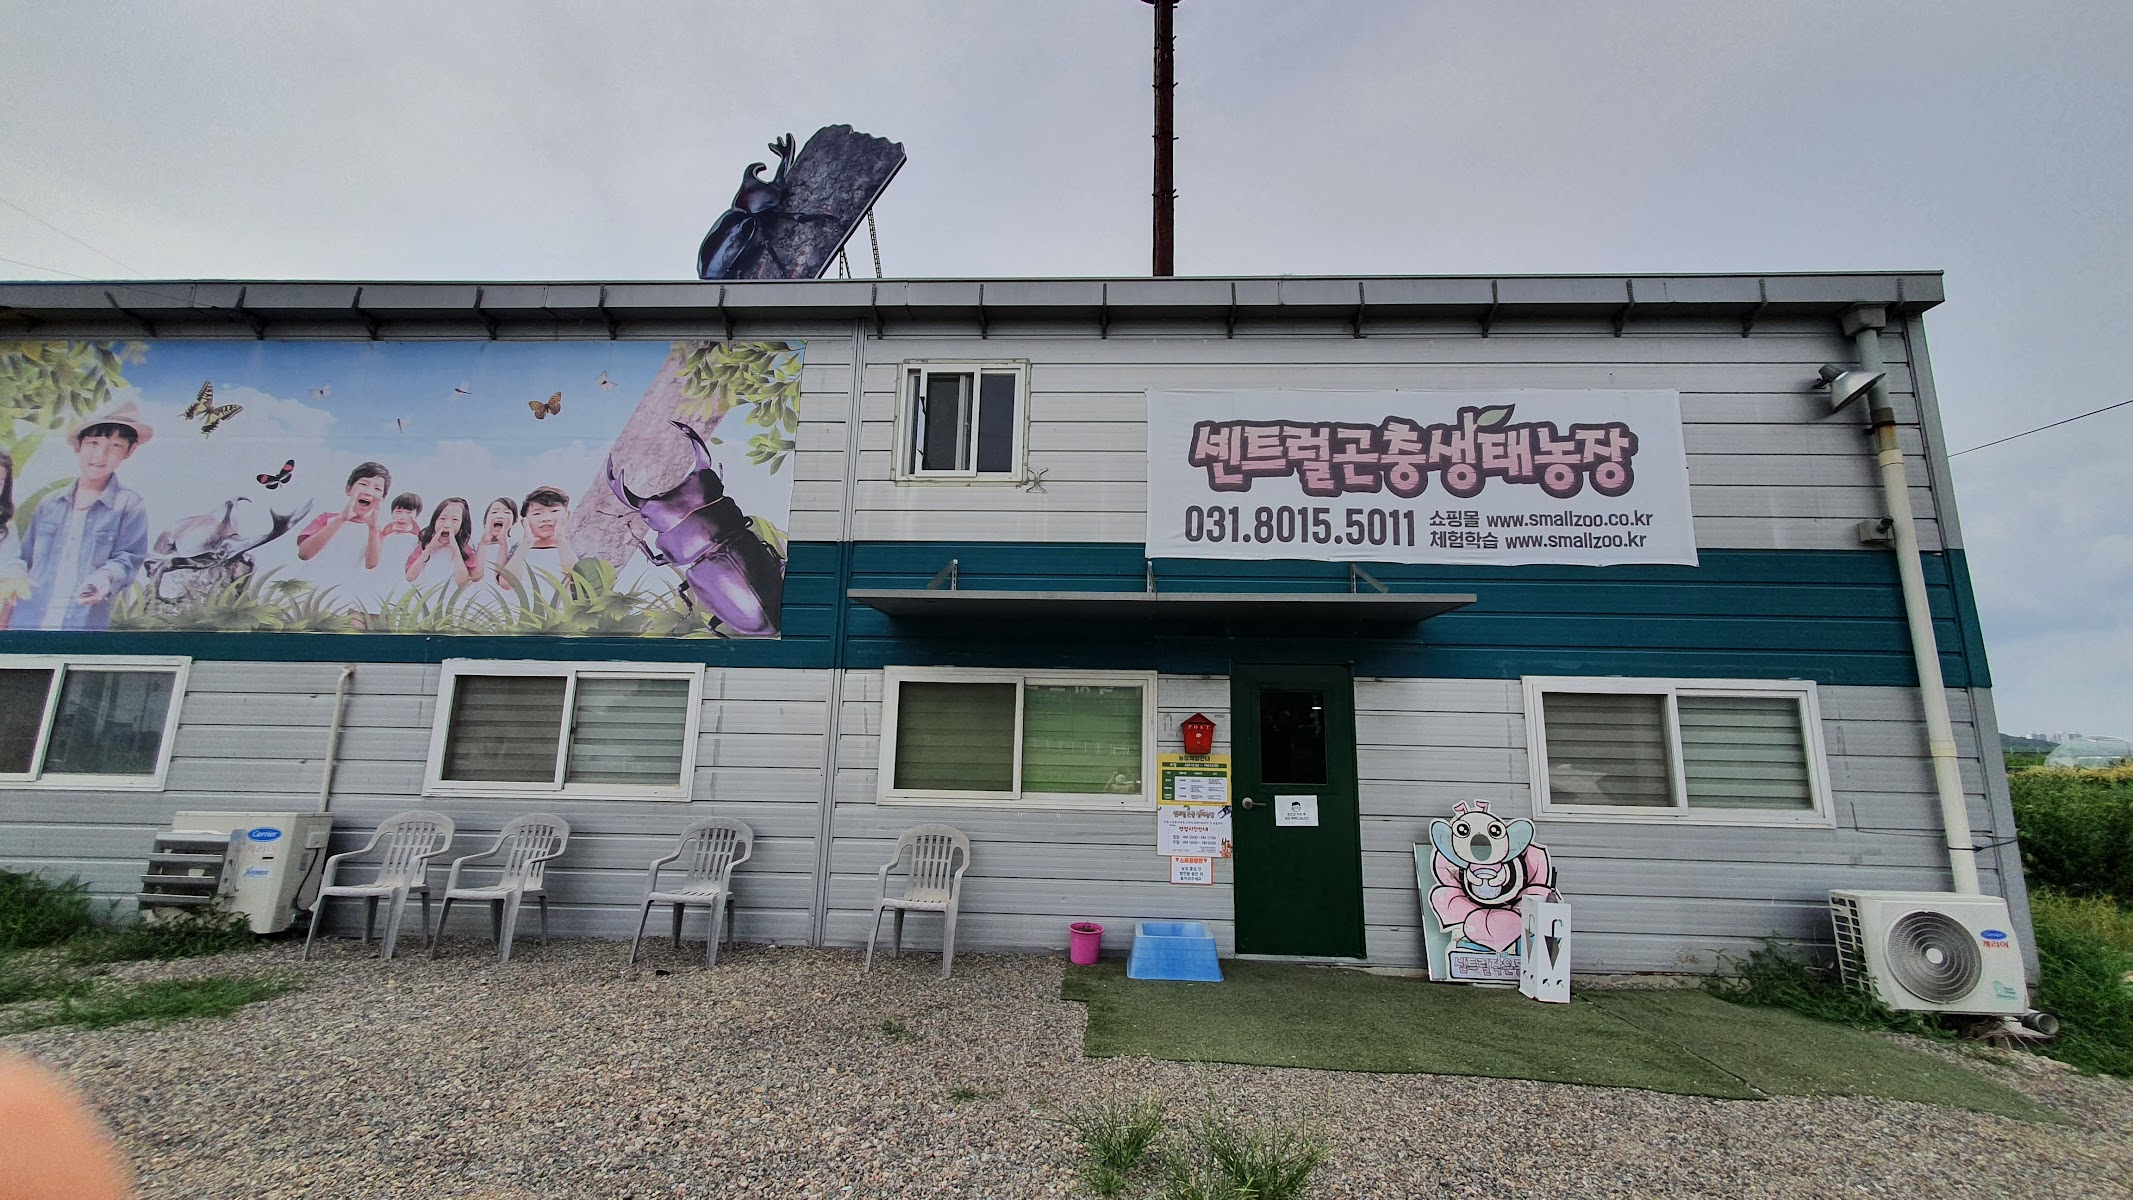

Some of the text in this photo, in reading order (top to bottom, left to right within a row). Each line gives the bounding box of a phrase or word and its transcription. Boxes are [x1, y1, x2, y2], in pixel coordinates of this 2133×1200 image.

[1189, 407, 1638, 498] 센트럴곤충생태농장
[1185, 505, 1416, 547] 031.8015.5011
[1429, 509, 1653, 528] 쇼핑몰 www.smallzoo.co.kr
[1430, 529, 1647, 550] 체험학습 www.smallzoo.kr
